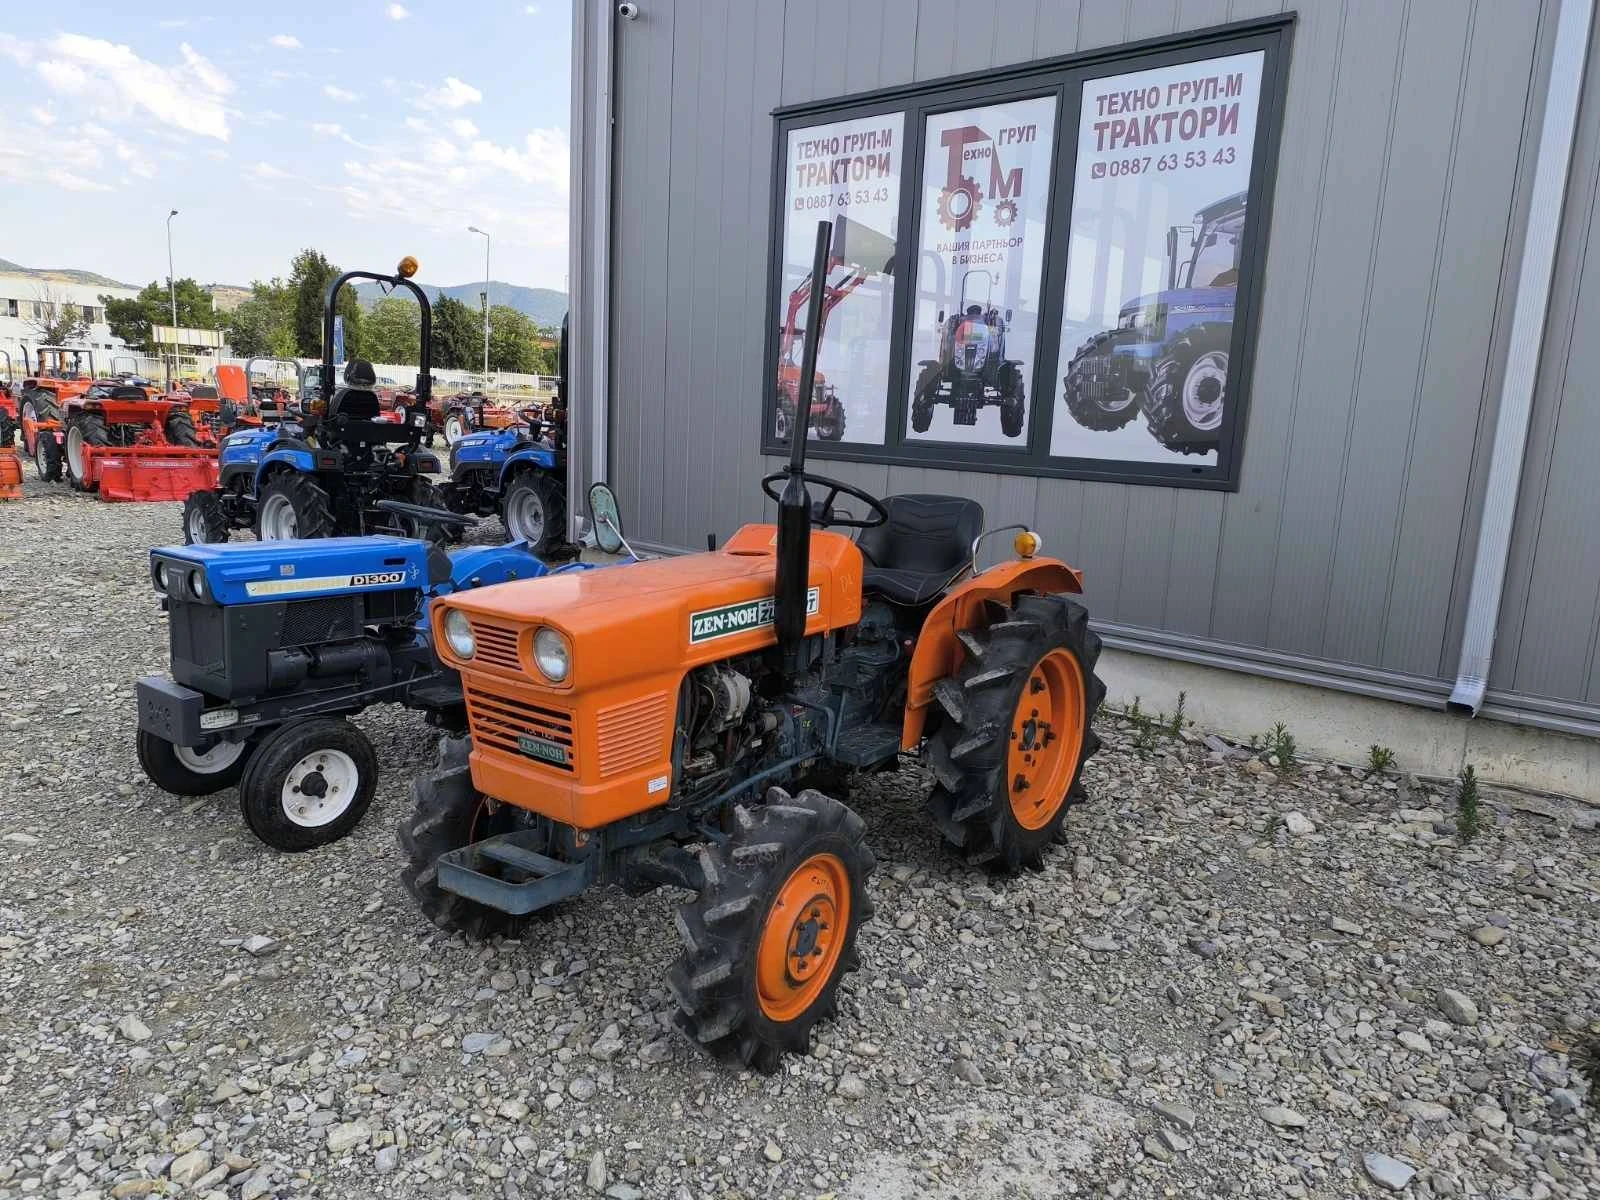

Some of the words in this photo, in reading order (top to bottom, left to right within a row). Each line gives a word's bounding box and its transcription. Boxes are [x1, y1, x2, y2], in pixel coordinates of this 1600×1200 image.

[1096, 86, 1161, 116] ТЕХНО
[1166, 73, 1243, 106] ГРУП-М
[1094, 102, 1240, 152] ТРАКТОРИ
[797, 136, 839, 160] ТЕХНО
[843, 128, 892, 154] ГРУП-М
[796, 151, 891, 189] ТРАКТОРИ
[1110, 157, 1152, 177] 0887
[1157, 154, 1178, 171] 63
[1184, 150, 1206, 168] 53
[1212, 147, 1236, 165] 43
[806, 193, 834, 210] 0887
[837, 191, 851, 207] 63
[855, 189, 870, 205] 53
[873, 187, 889, 202] 43
[937, 240, 970, 253] ВАШИЯ
[952, 255, 957, 265] В
[960, 253, 1004, 265] БИЗНЕСА
[353, 573, 400, 585] D1300
[693, 606, 758, 637] ZEN-NOH
